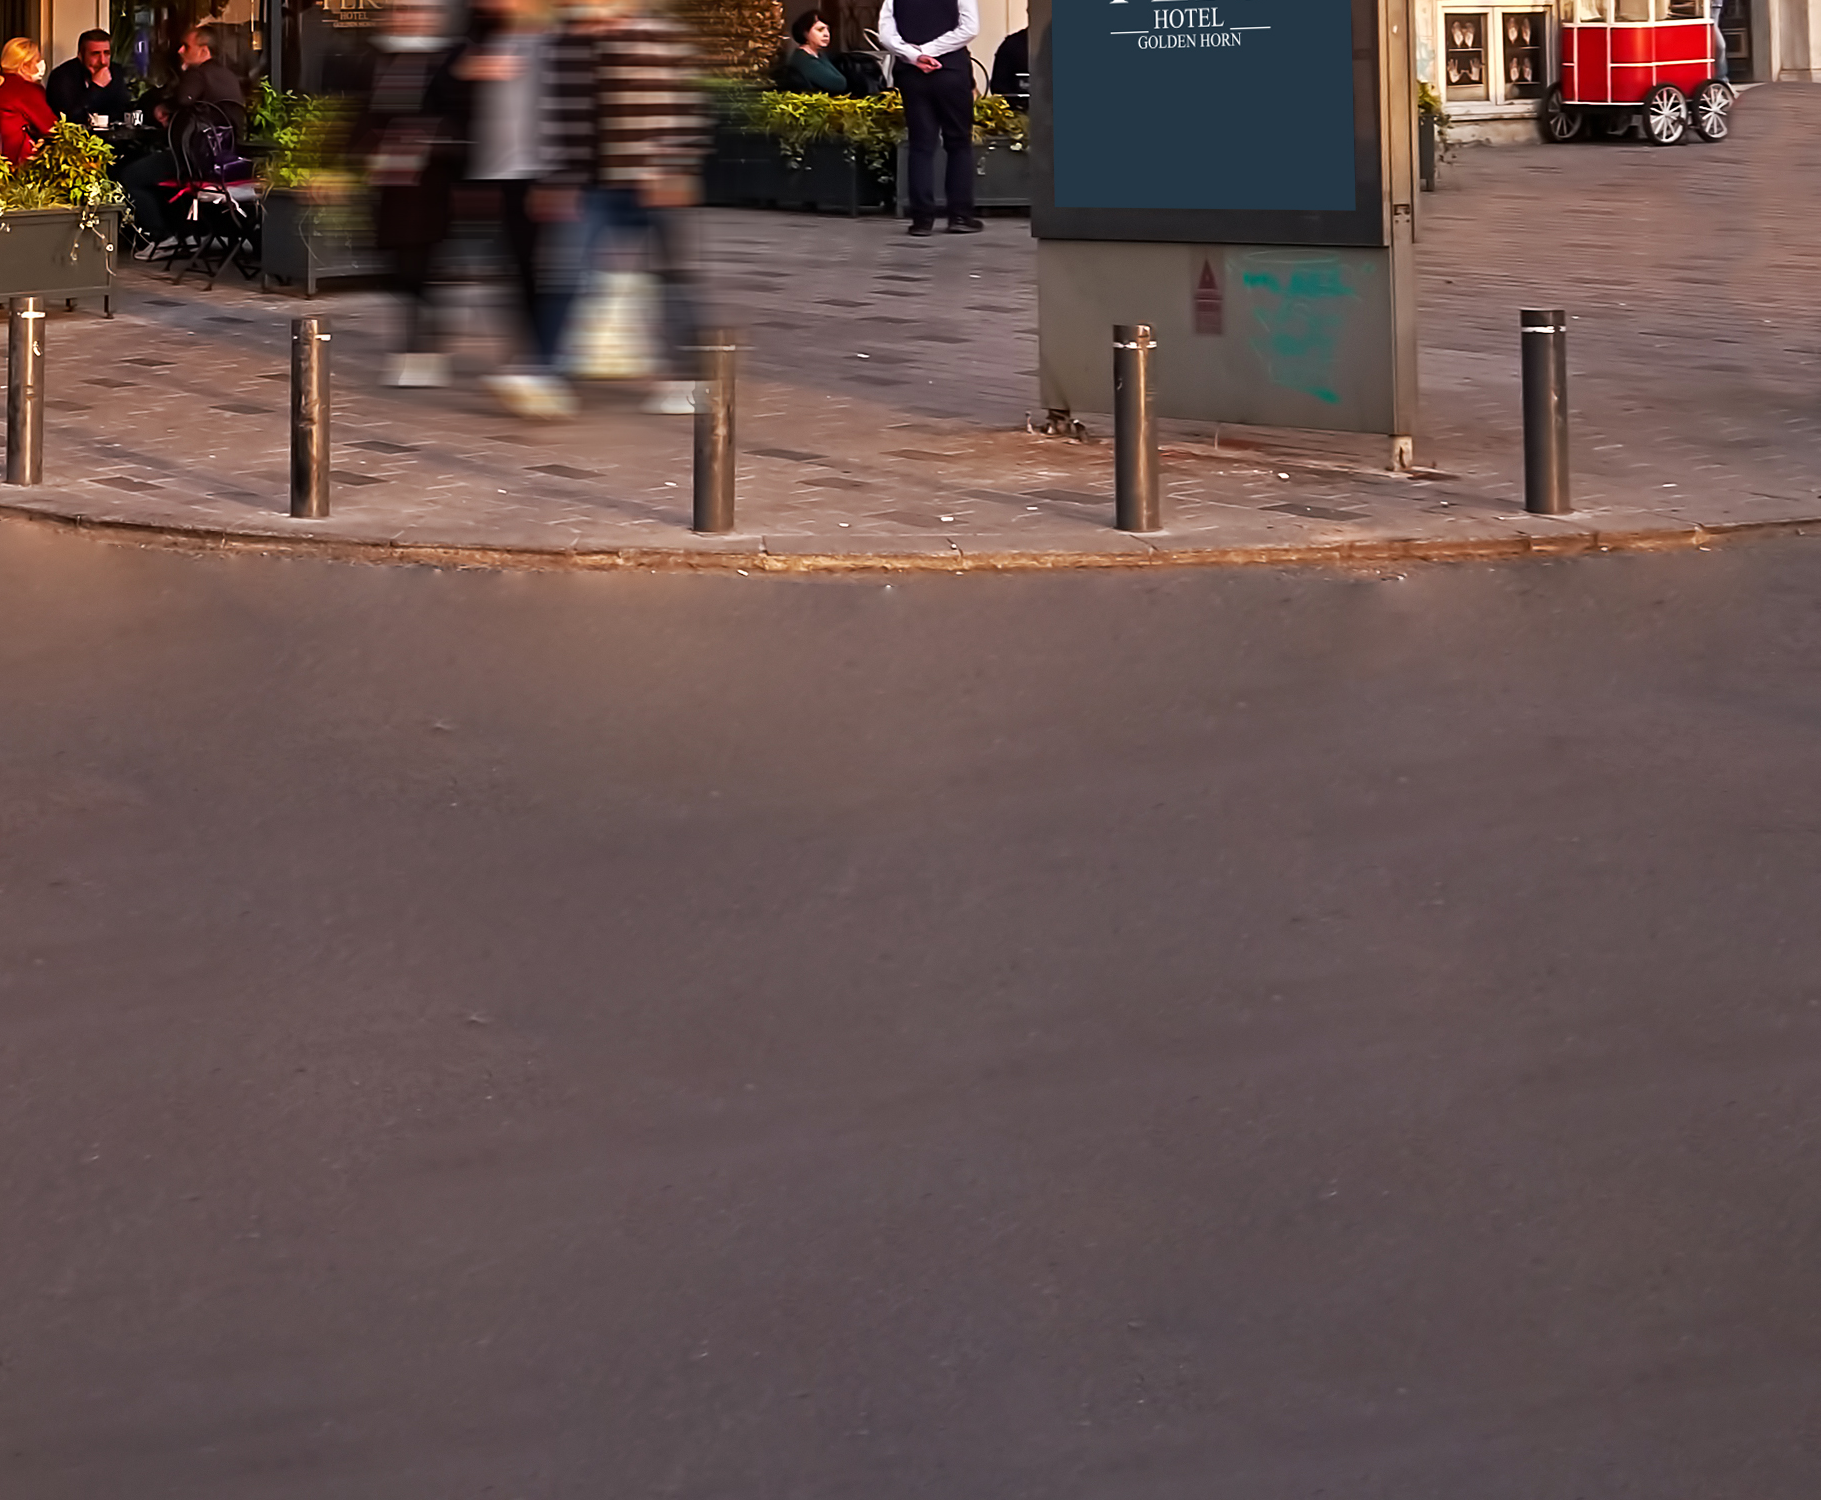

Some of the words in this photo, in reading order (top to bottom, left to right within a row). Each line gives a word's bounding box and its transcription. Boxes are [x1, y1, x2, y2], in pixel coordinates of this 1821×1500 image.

[1153, 7, 1225, 29] HOTEL
[1137, 33, 1197, 49] GOLDEN
[1200, 32, 1242, 47] HORN
